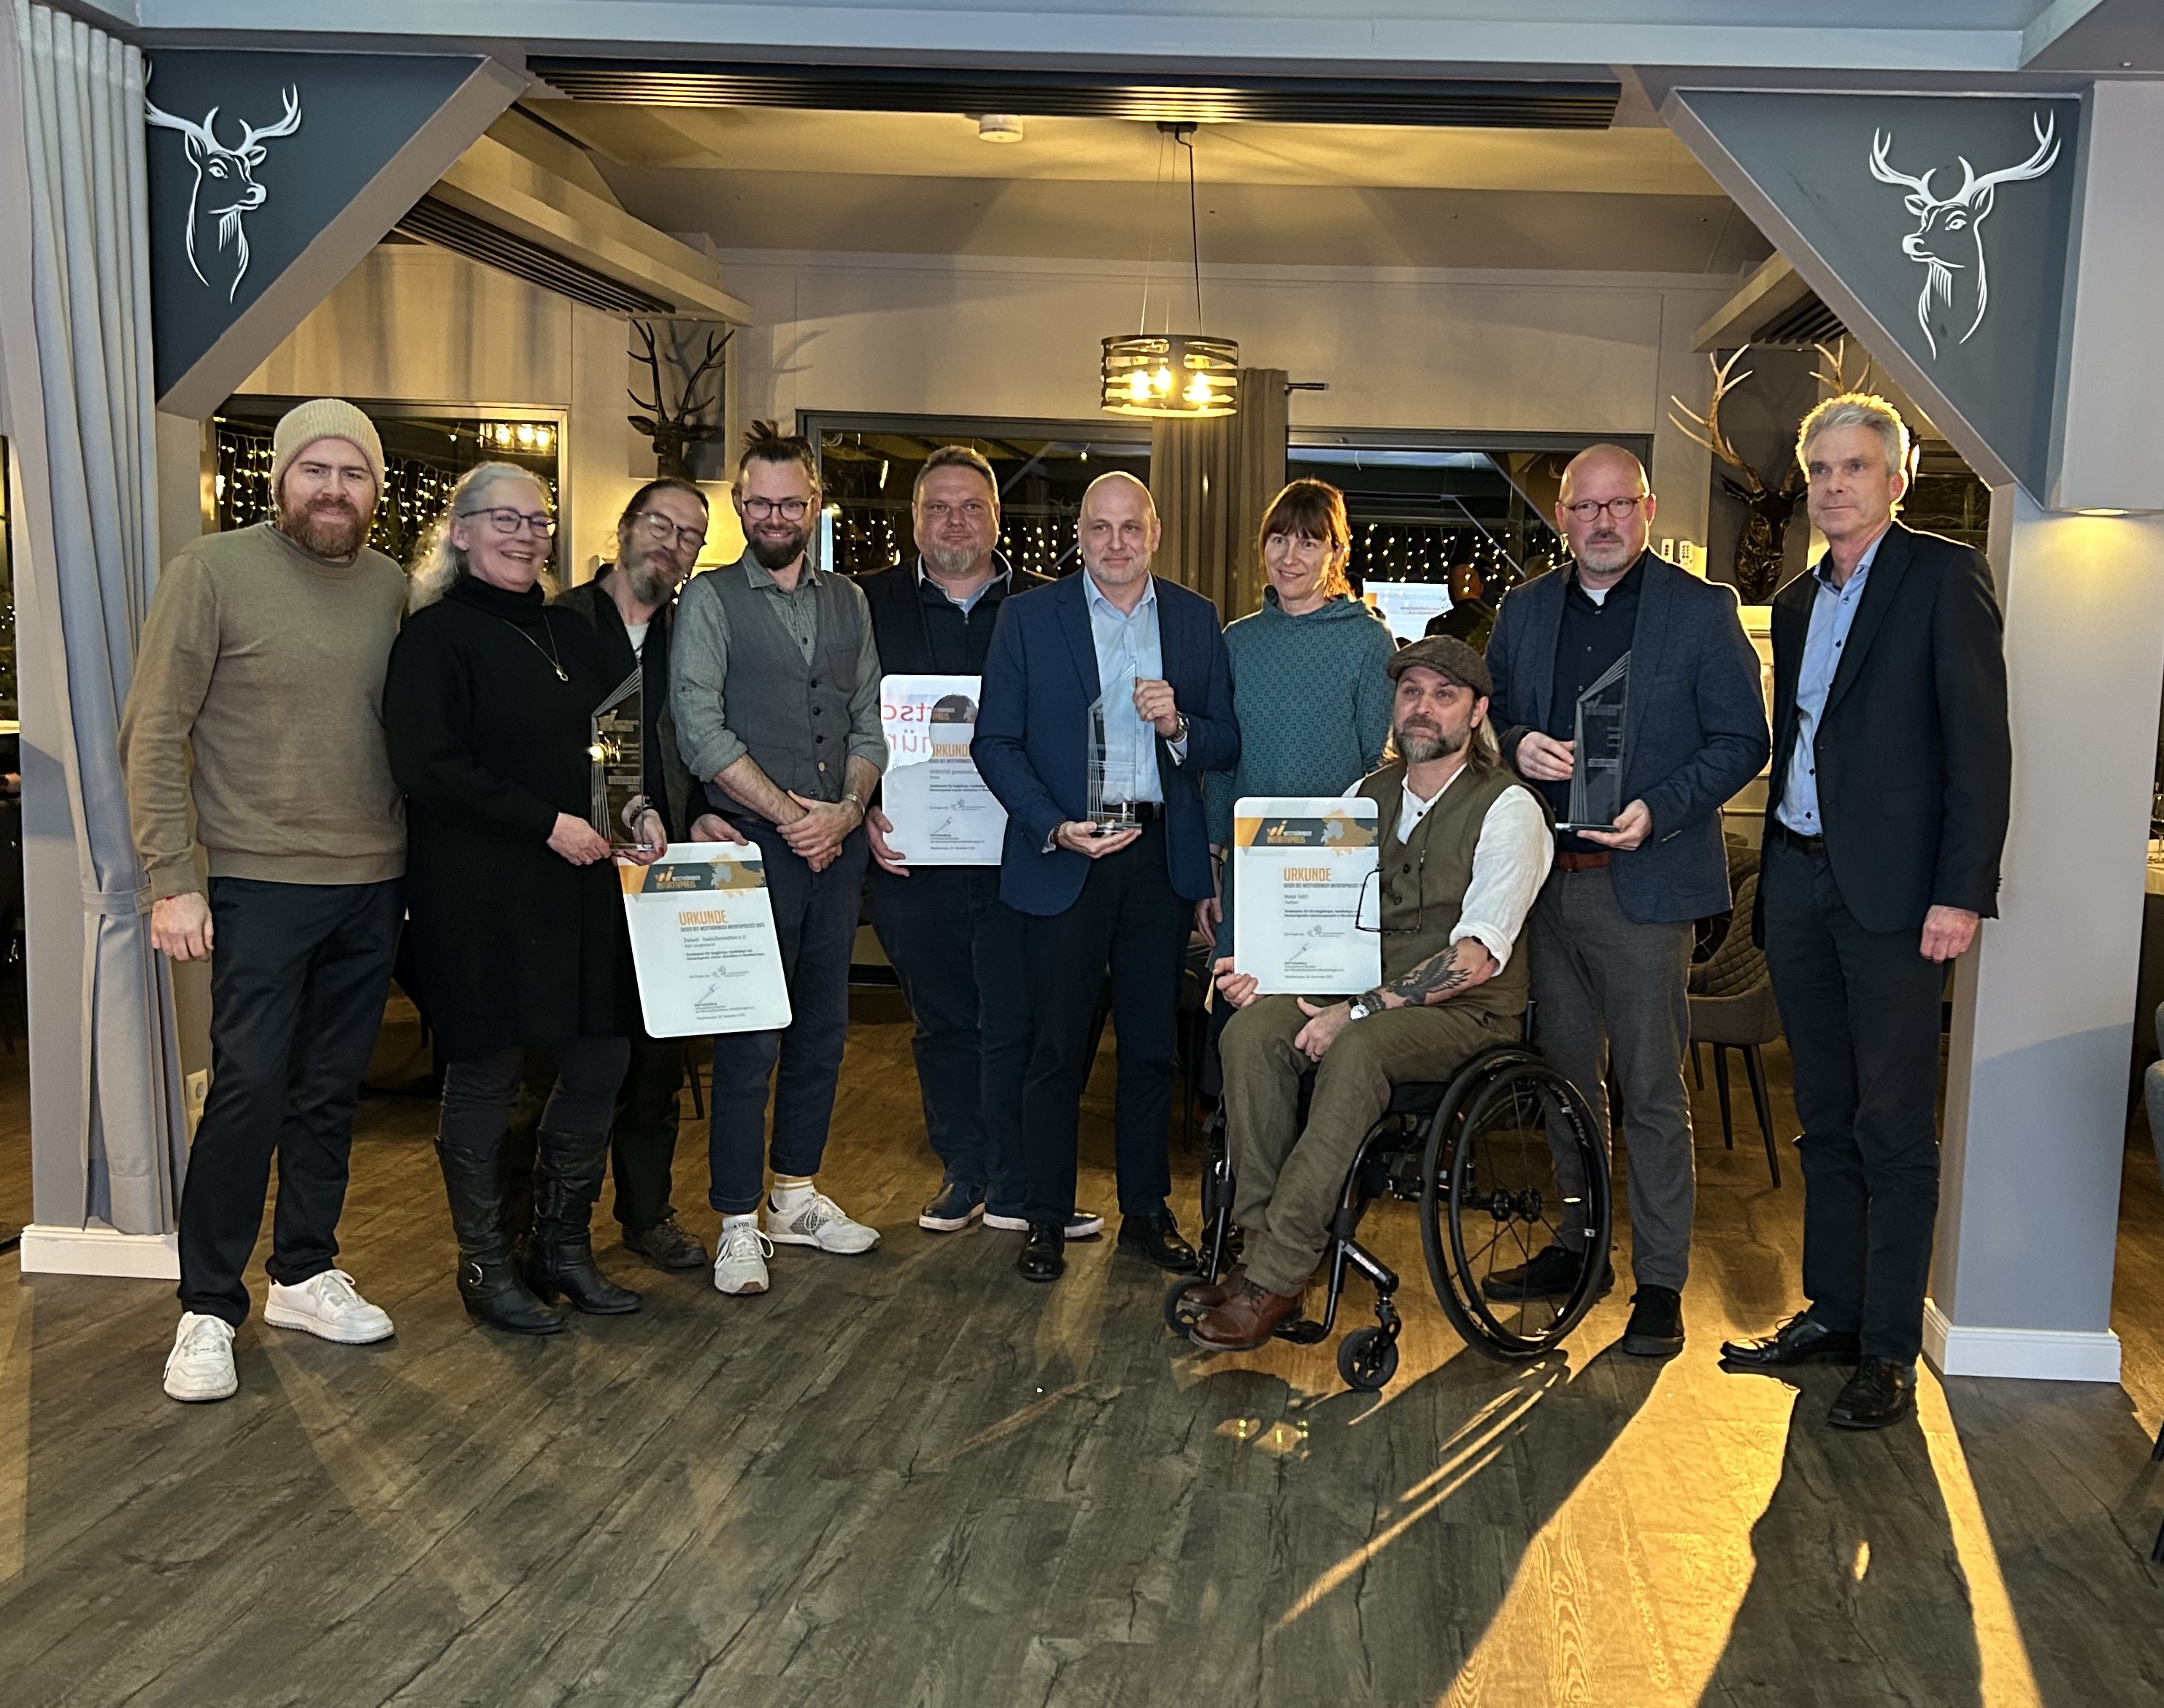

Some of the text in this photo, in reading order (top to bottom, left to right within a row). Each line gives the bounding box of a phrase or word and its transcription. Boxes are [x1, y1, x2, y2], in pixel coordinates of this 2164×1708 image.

[933, 743, 971, 757] RKUND
[1284, 867, 1331, 882] URKUNDE
[679, 909, 728, 926] URKUNDE
